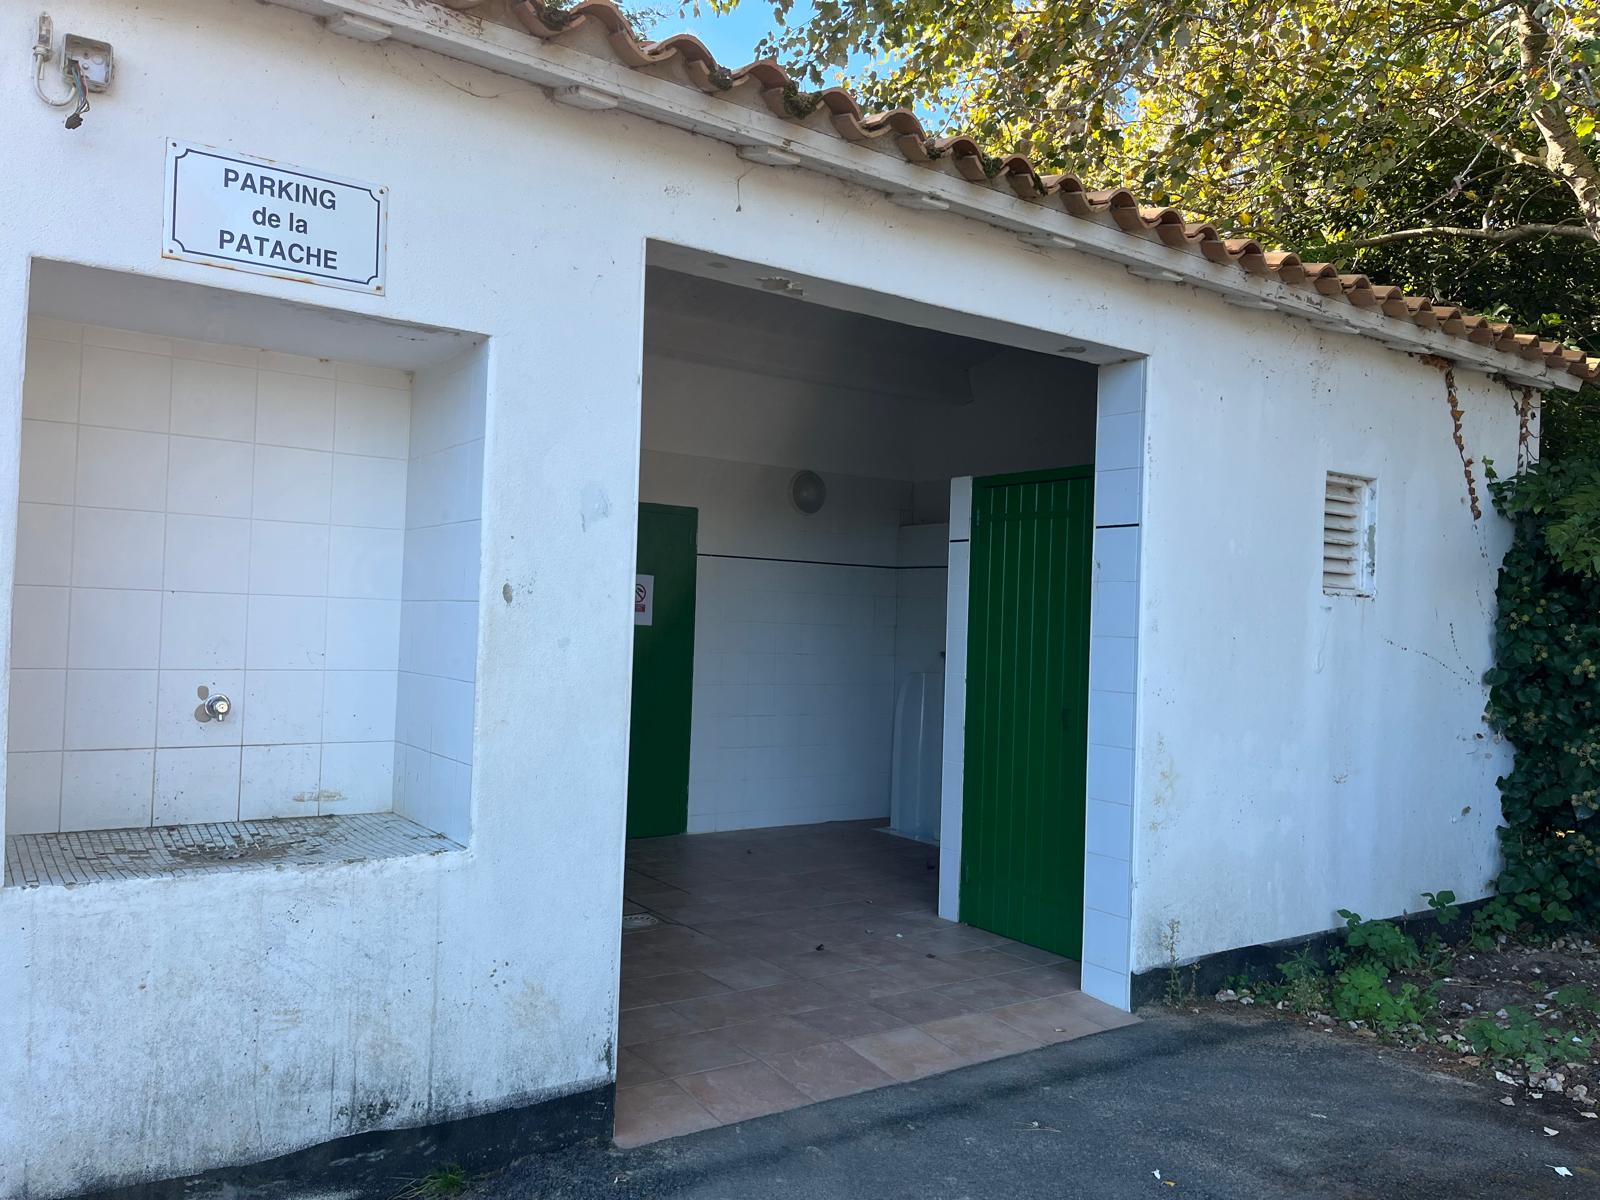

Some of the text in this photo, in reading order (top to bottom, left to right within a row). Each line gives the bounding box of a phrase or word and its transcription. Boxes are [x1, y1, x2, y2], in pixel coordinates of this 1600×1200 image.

[223, 167, 336, 211] PARKING
[252, 206, 308, 235] de la
[219, 229, 338, 270] PATACHE
